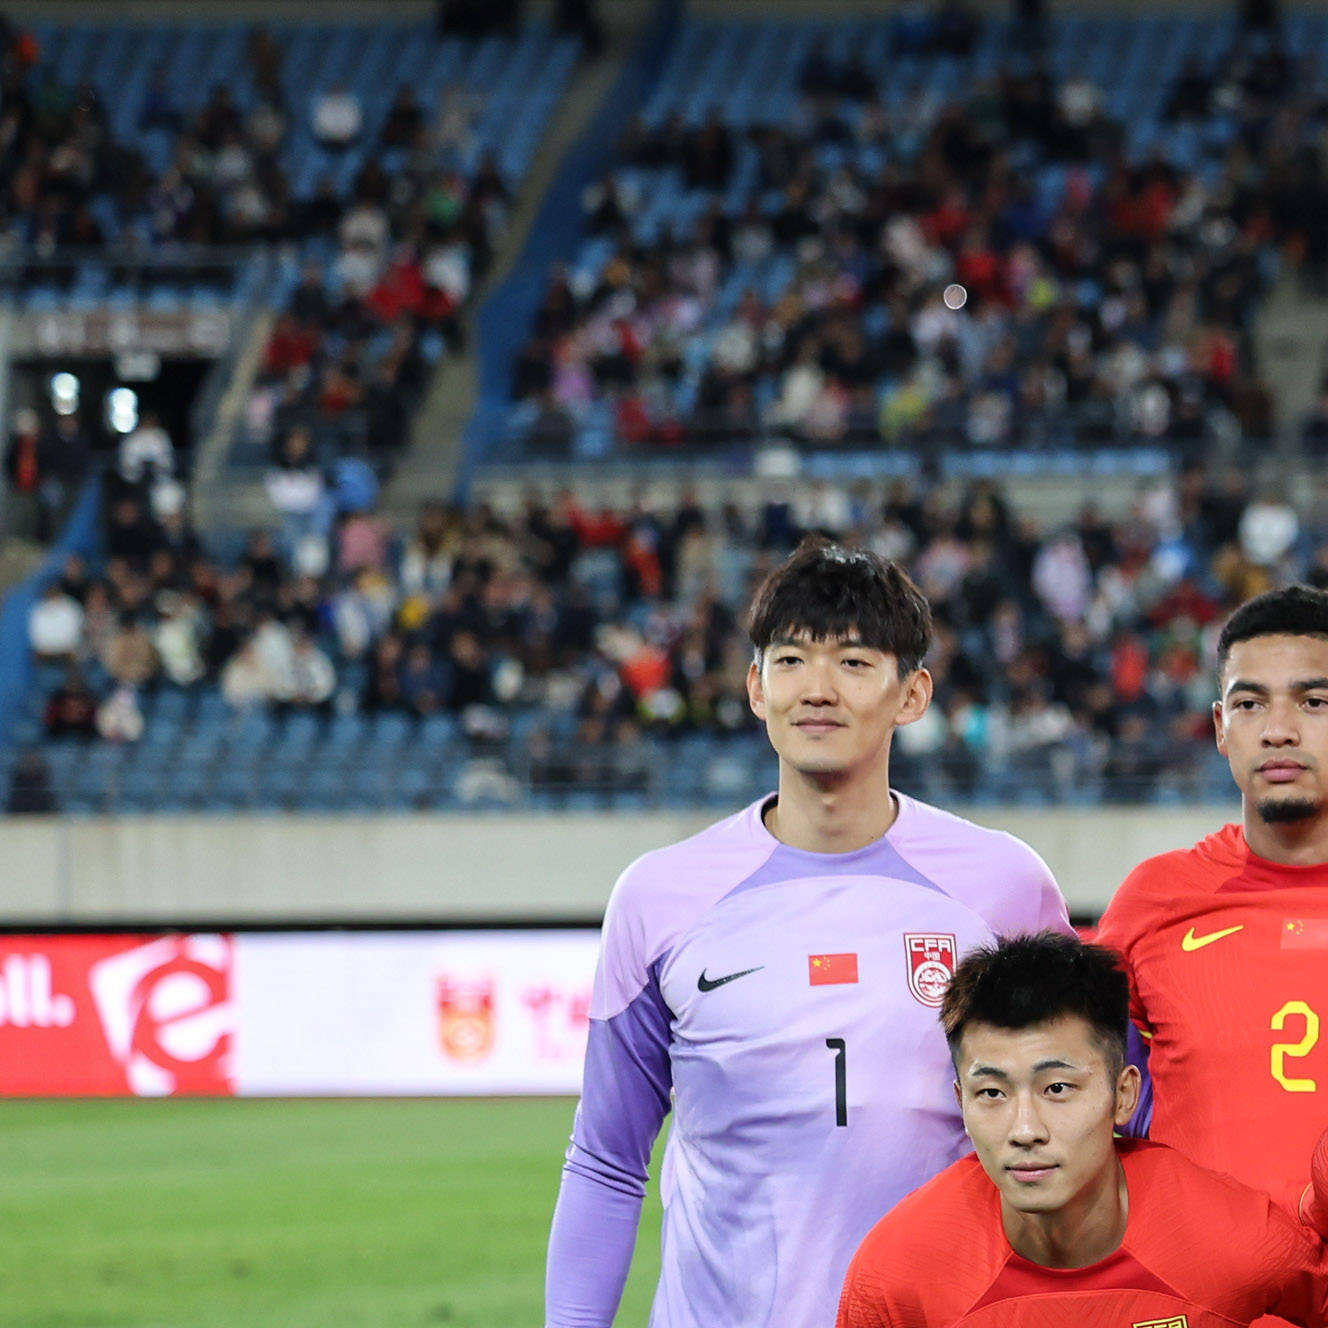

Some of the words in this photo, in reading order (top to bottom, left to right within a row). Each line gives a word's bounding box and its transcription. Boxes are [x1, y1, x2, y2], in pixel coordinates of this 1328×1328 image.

[910, 939, 952, 953] CFA
[825, 1038, 848, 1127] 1
[1271, 1001, 1320, 1092] 2
